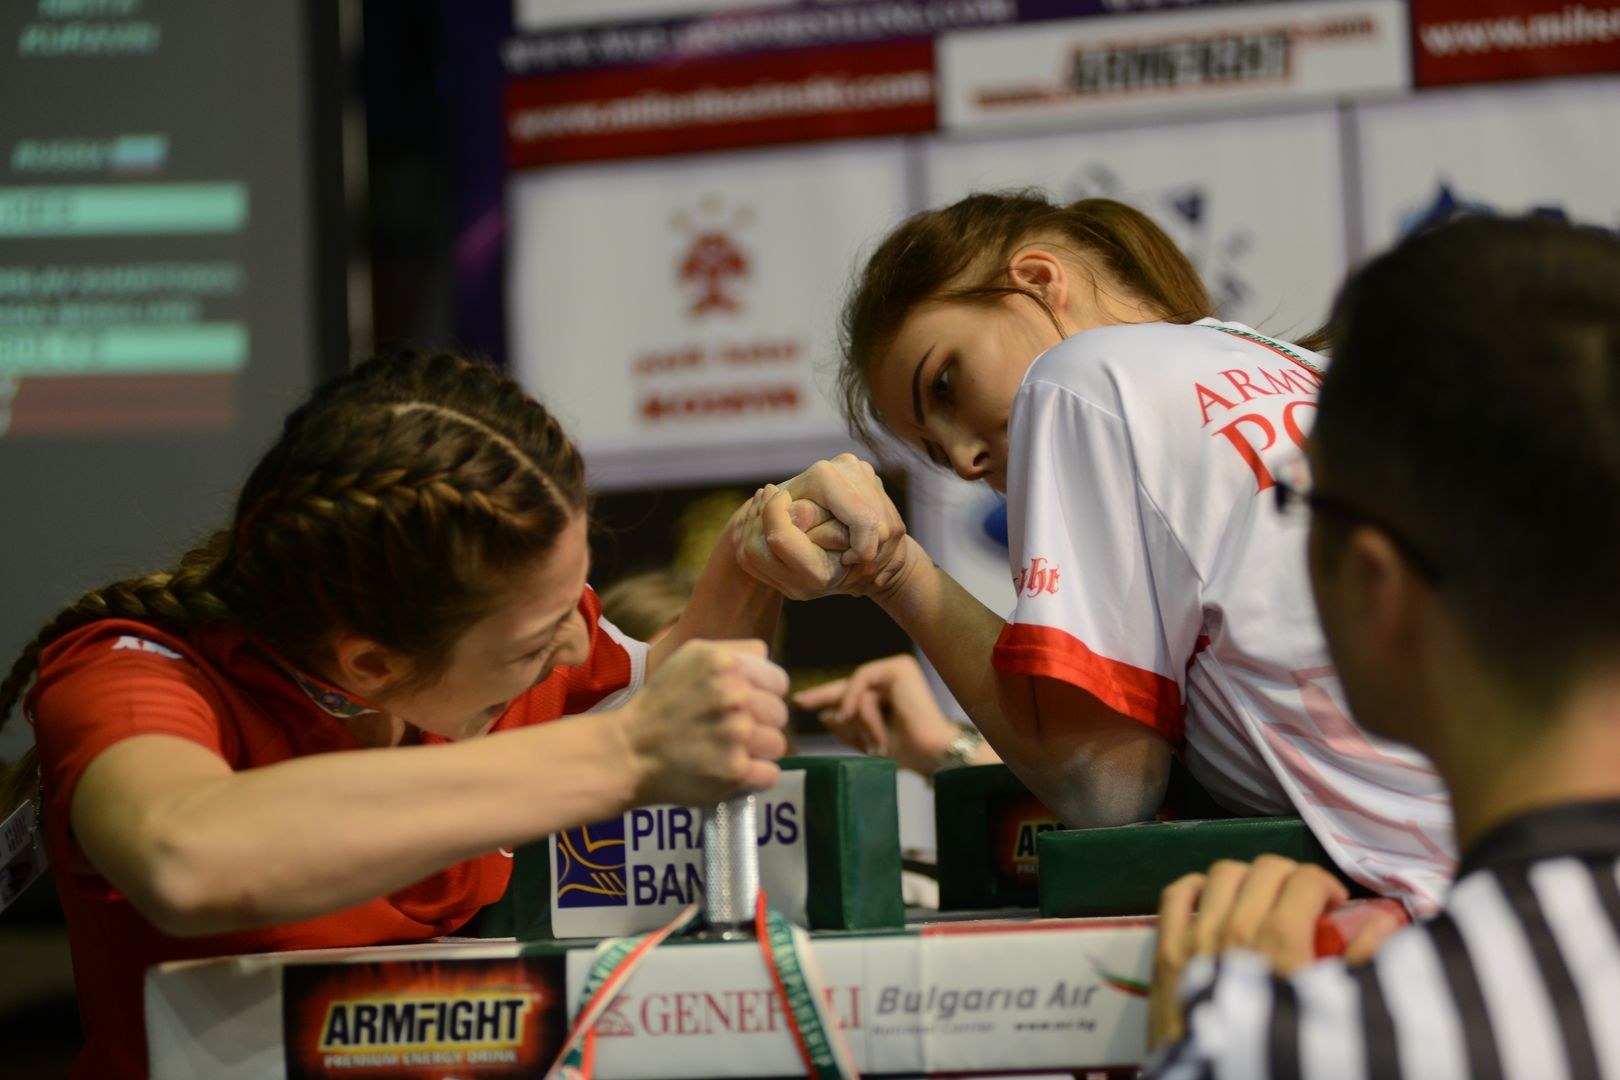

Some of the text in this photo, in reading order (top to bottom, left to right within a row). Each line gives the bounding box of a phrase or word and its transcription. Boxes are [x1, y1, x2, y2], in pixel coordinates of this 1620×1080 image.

[631, 801, 799, 851] PIRUS
[632, 863, 706, 906] BAN
[639, 984, 864, 1036] GENELI
[876, 981, 1099, 1019] Bulgaria Air
[323, 999, 524, 1047] ARMFIGHT
[324, 1050, 517, 1068] PREMIUM ENERGY DRINK
